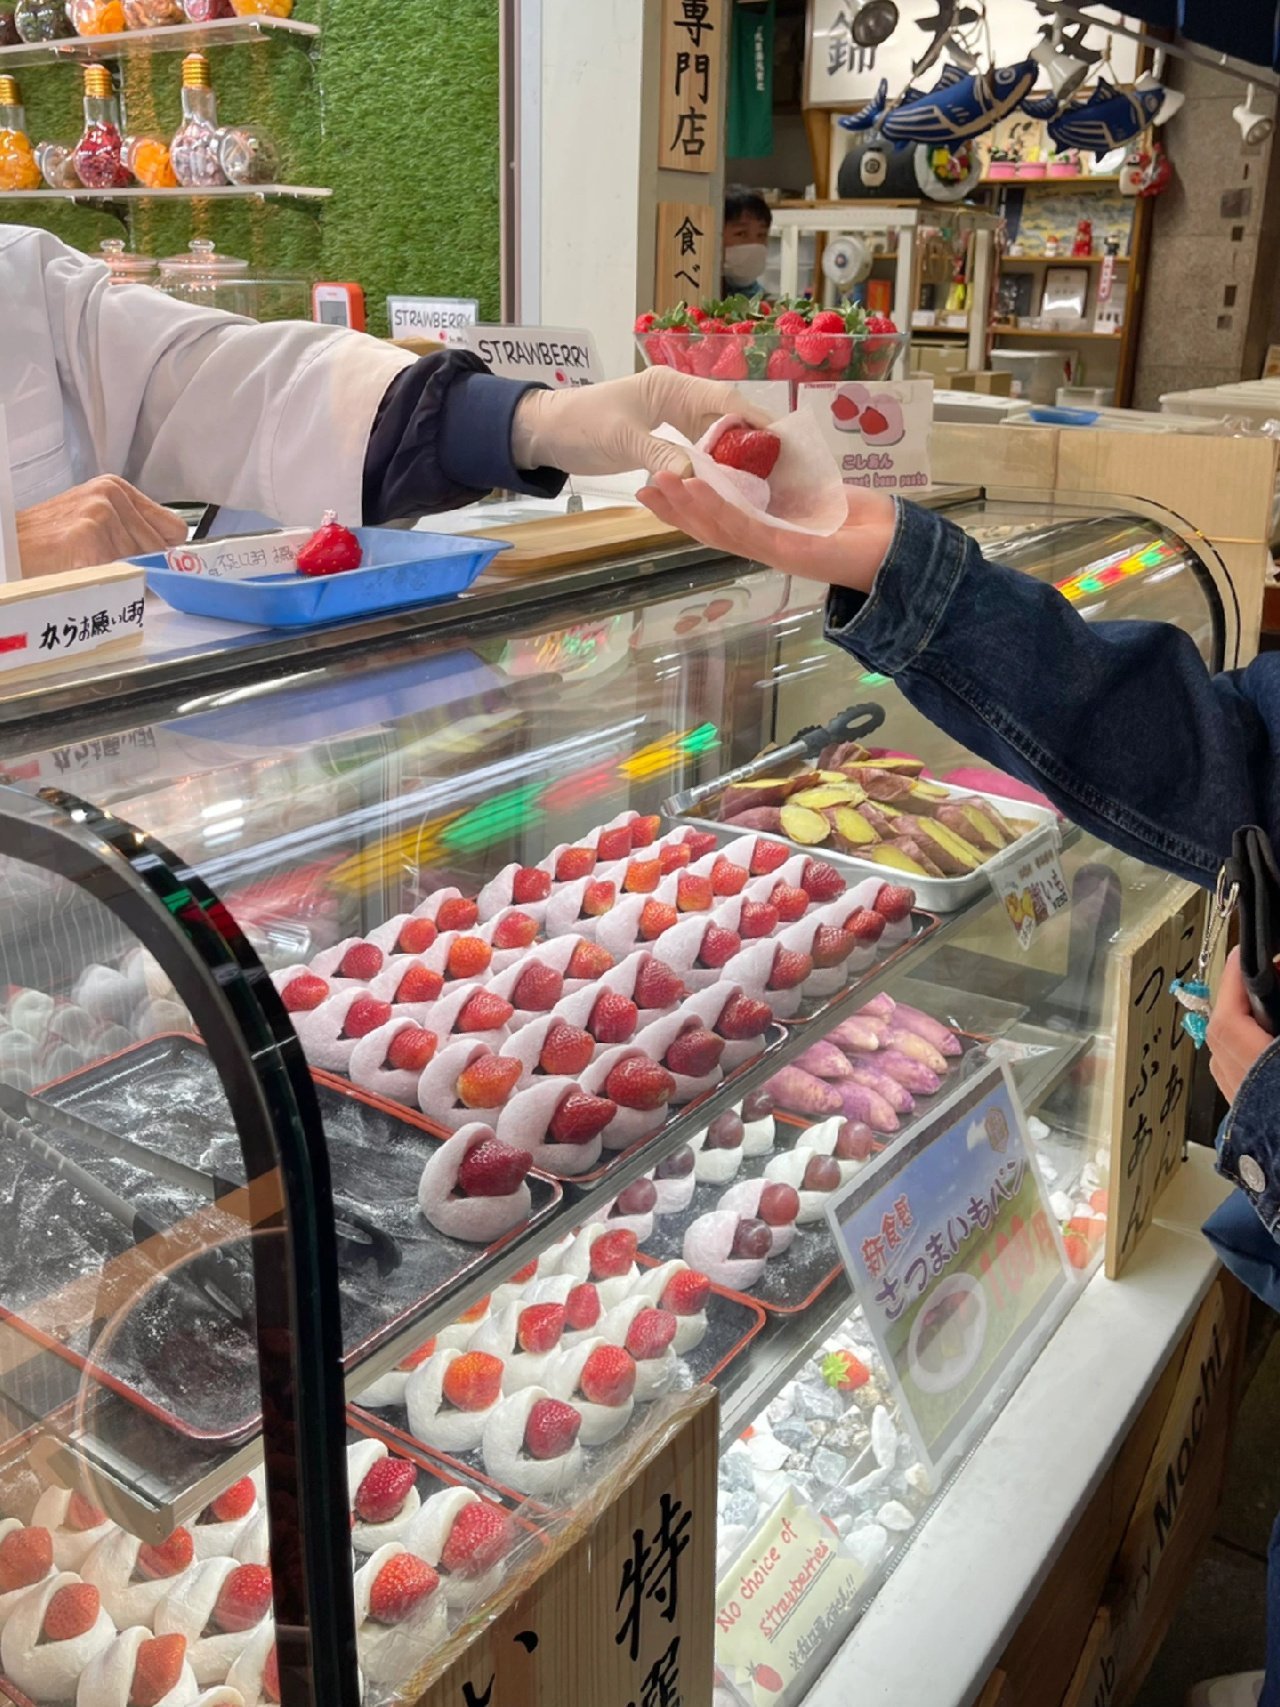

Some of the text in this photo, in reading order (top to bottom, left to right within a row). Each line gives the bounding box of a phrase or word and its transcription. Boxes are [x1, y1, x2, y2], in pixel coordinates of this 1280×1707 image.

[394, 309, 471, 330] STRAWBERRY
[478, 340, 591, 369] STRAWBERRY
[842, 452, 894, 471] こしあん
[1122, 966, 1165, 1254] つぶあん
[1152, 1323, 1223, 1550] Mochi
[715, 1517, 798, 1634] No choice of
